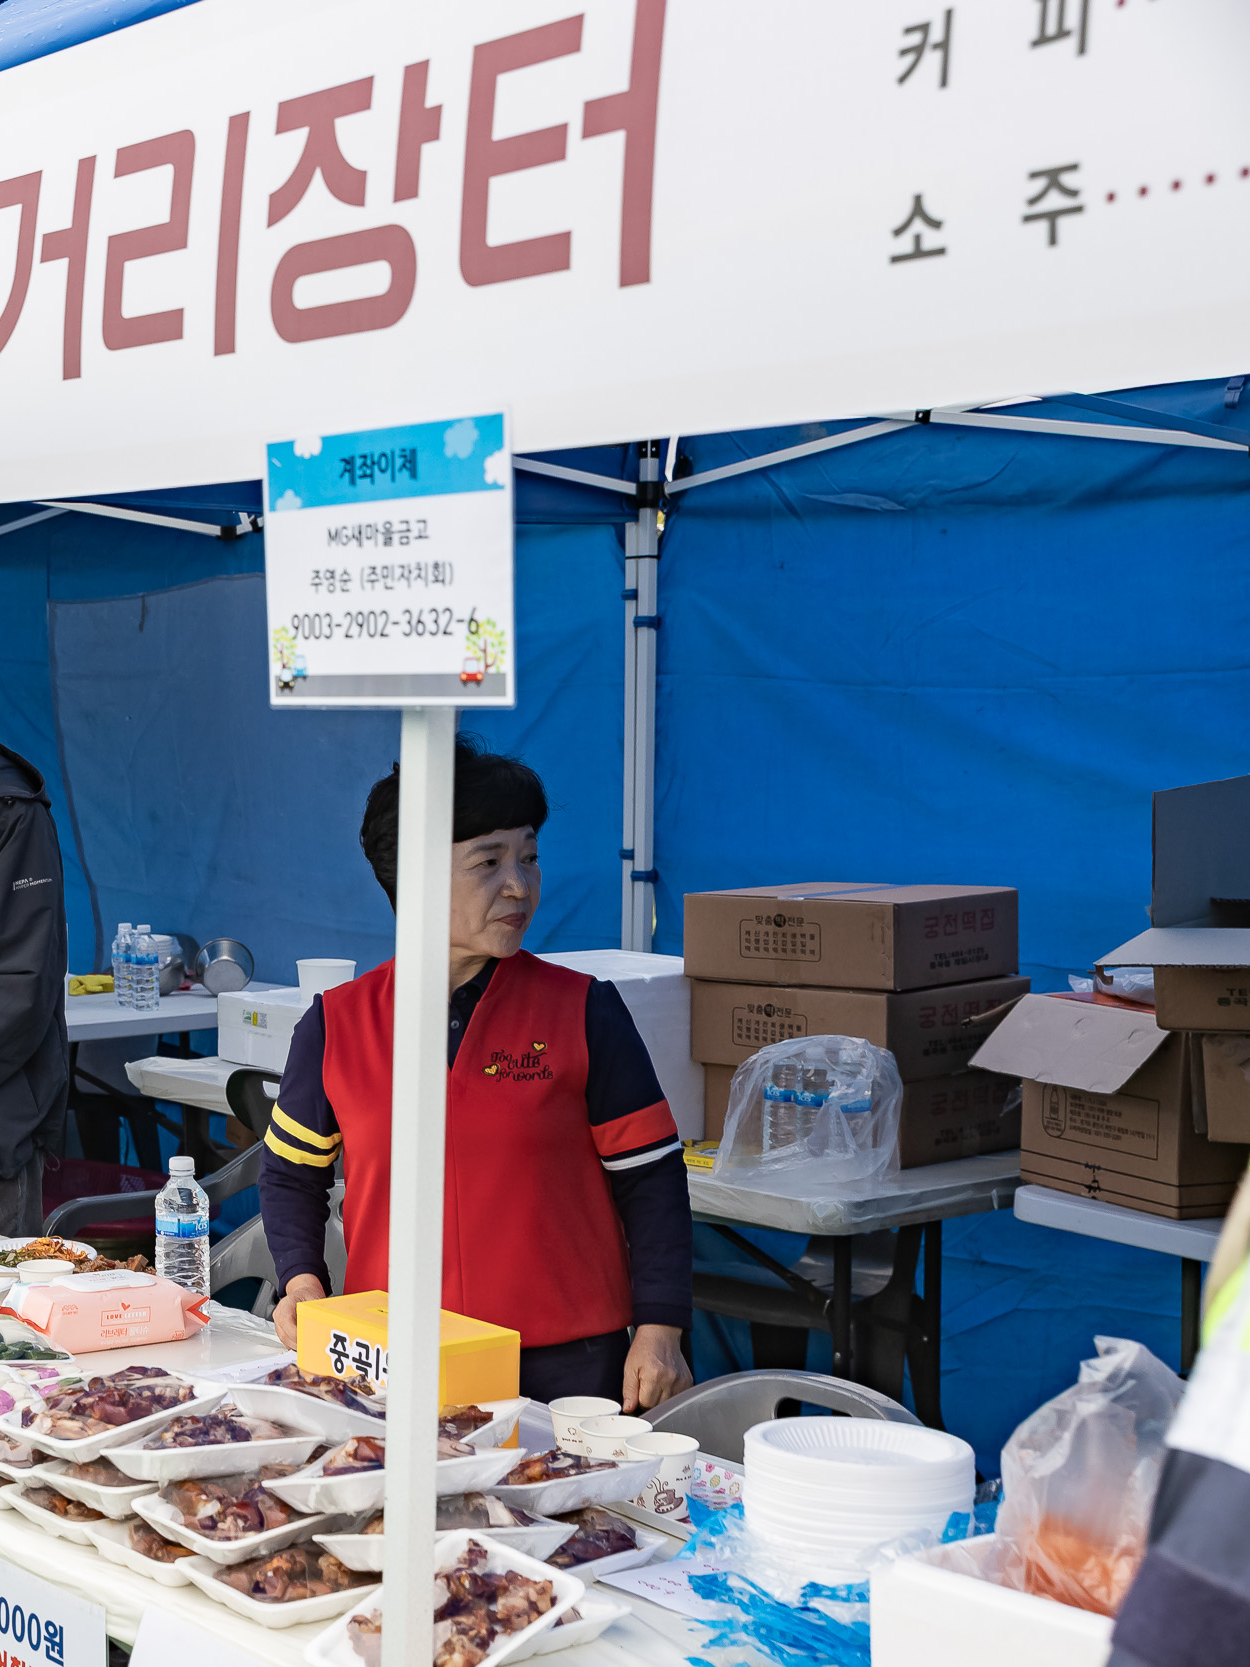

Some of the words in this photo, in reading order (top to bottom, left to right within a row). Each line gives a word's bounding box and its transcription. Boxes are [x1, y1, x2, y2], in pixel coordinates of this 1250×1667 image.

[339, 448, 417, 486] 계좌이체
[327, 519, 429, 547] MG새마을금고
[360, 561, 454, 590] (주민자치회)
[291, 607, 479, 640] 9003-2902-3632-6
[924, 908, 995, 939] 궁전떡집
[496, 1068, 513, 1082] for
[513, 1065, 553, 1081] words
[330, 1333, 388, 1380] 중곡1
